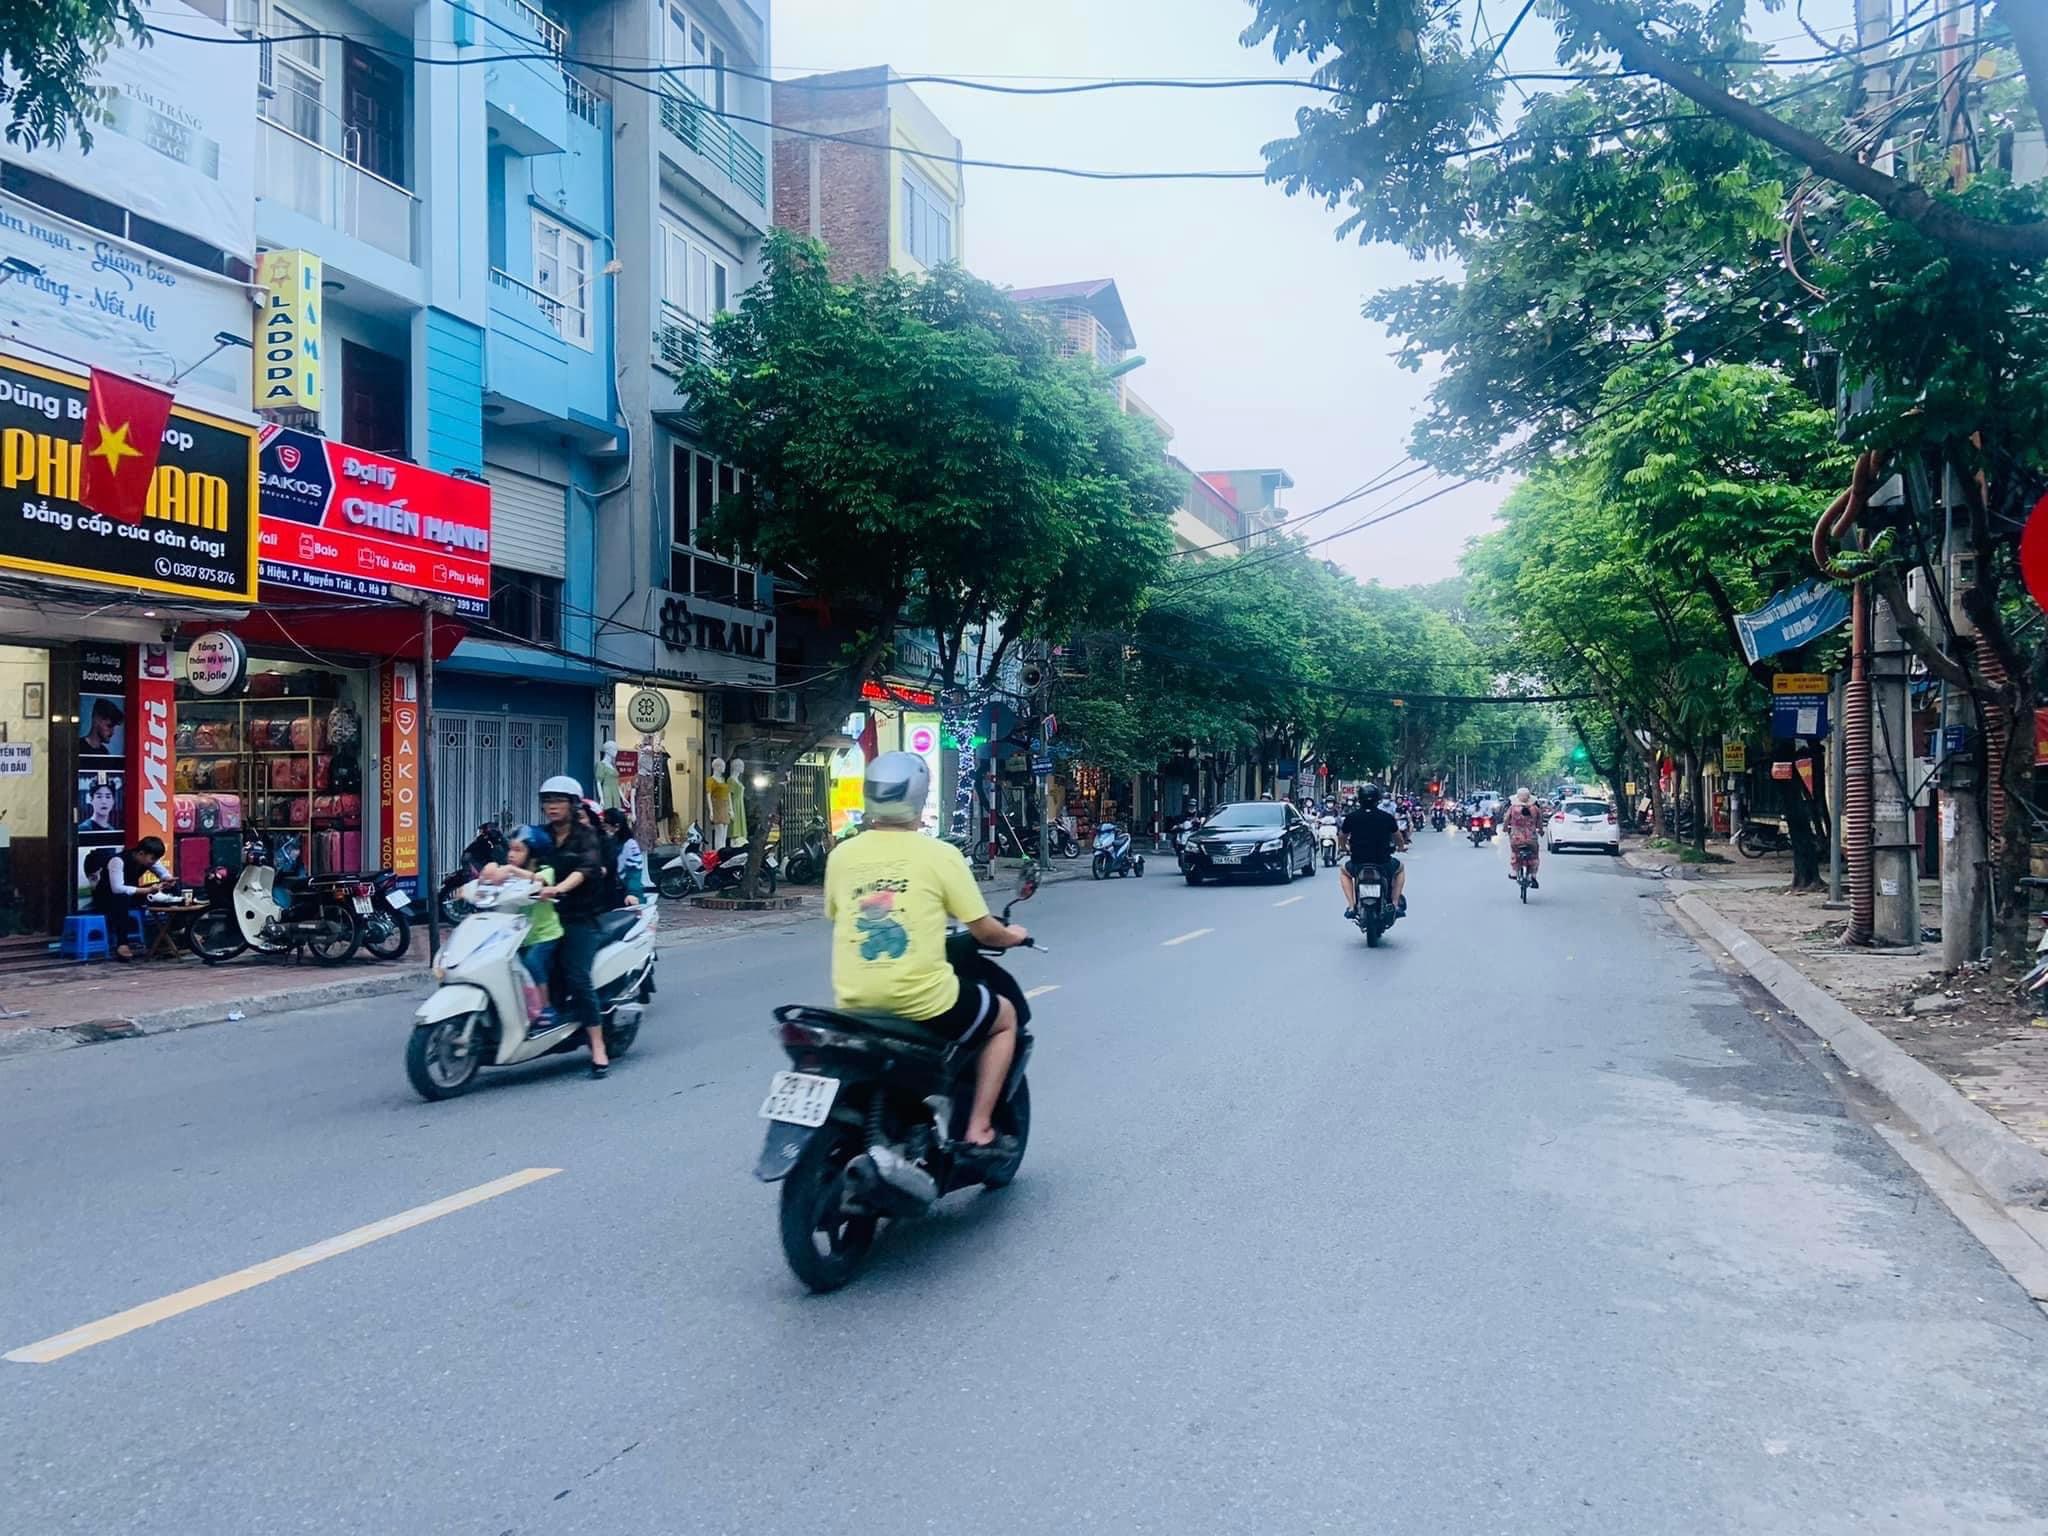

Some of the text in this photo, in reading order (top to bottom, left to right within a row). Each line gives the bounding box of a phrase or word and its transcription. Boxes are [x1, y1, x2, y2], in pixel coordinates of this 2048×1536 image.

[30, 222, 73, 251] mụn
[147, 260, 176, 287] béo
[267, 295, 294, 398] LADODA
[0, 379, 60, 420] Dũng
[258, 470, 322, 498] SAKOS
[22, 501, 73, 531] Đẳng
[77, 513, 113, 537] cấp
[154, 528, 186, 549] đàn
[190, 535, 226, 558] ông!
[423, 515, 489, 553] HẠNH
[173, 561, 236, 585] 0387 875 876
[303, 571, 334, 587] Nguyễn
[314, 543, 338, 558] Balo
[375, 554, 390, 569] Túi
[391, 559, 416, 574] xách
[448, 569, 465, 585] Phụ
[218, 642, 224, 650] 3
[82, 669, 124, 685] Barbershop
[144, 698, 169, 833] Miti
[382, 754, 393, 808] LADODA
